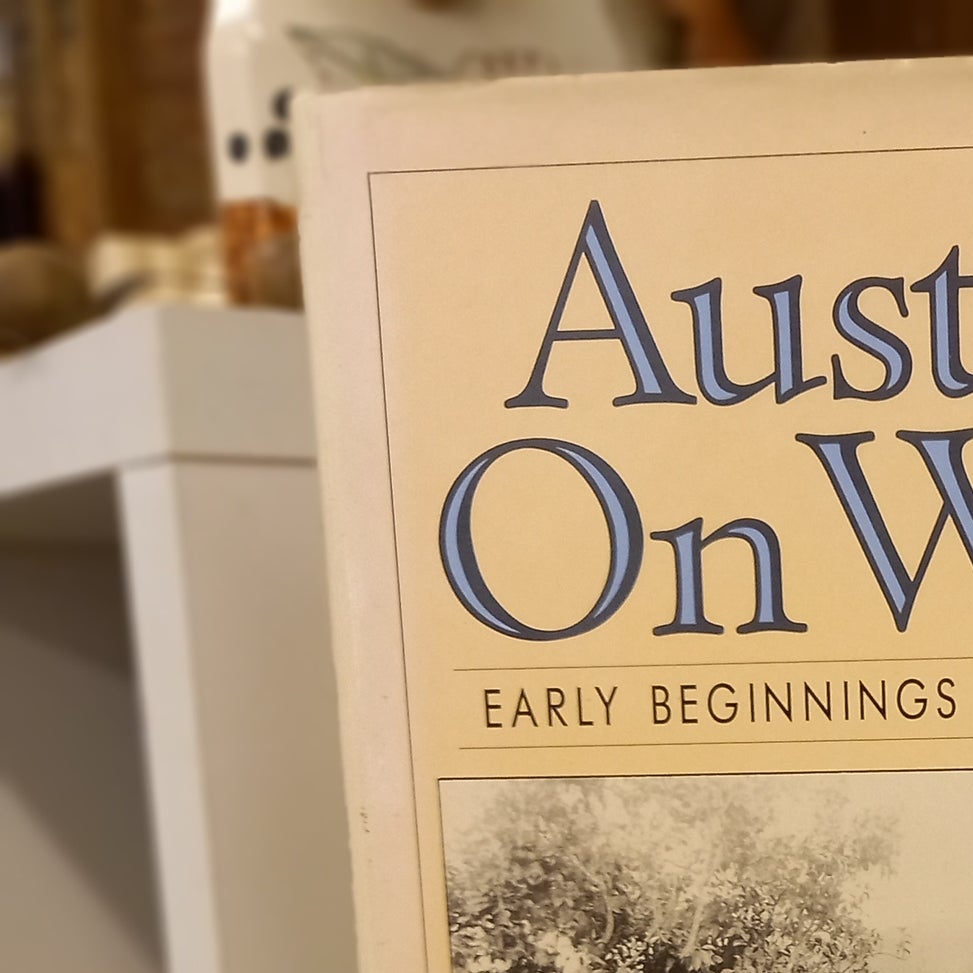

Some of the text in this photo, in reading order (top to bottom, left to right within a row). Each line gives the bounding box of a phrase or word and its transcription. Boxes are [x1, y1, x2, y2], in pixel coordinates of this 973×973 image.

[438, 436, 808, 642] On
[484, 686, 619, 728] EARLY
[651, 677, 957, 725] BEGINNINGS
